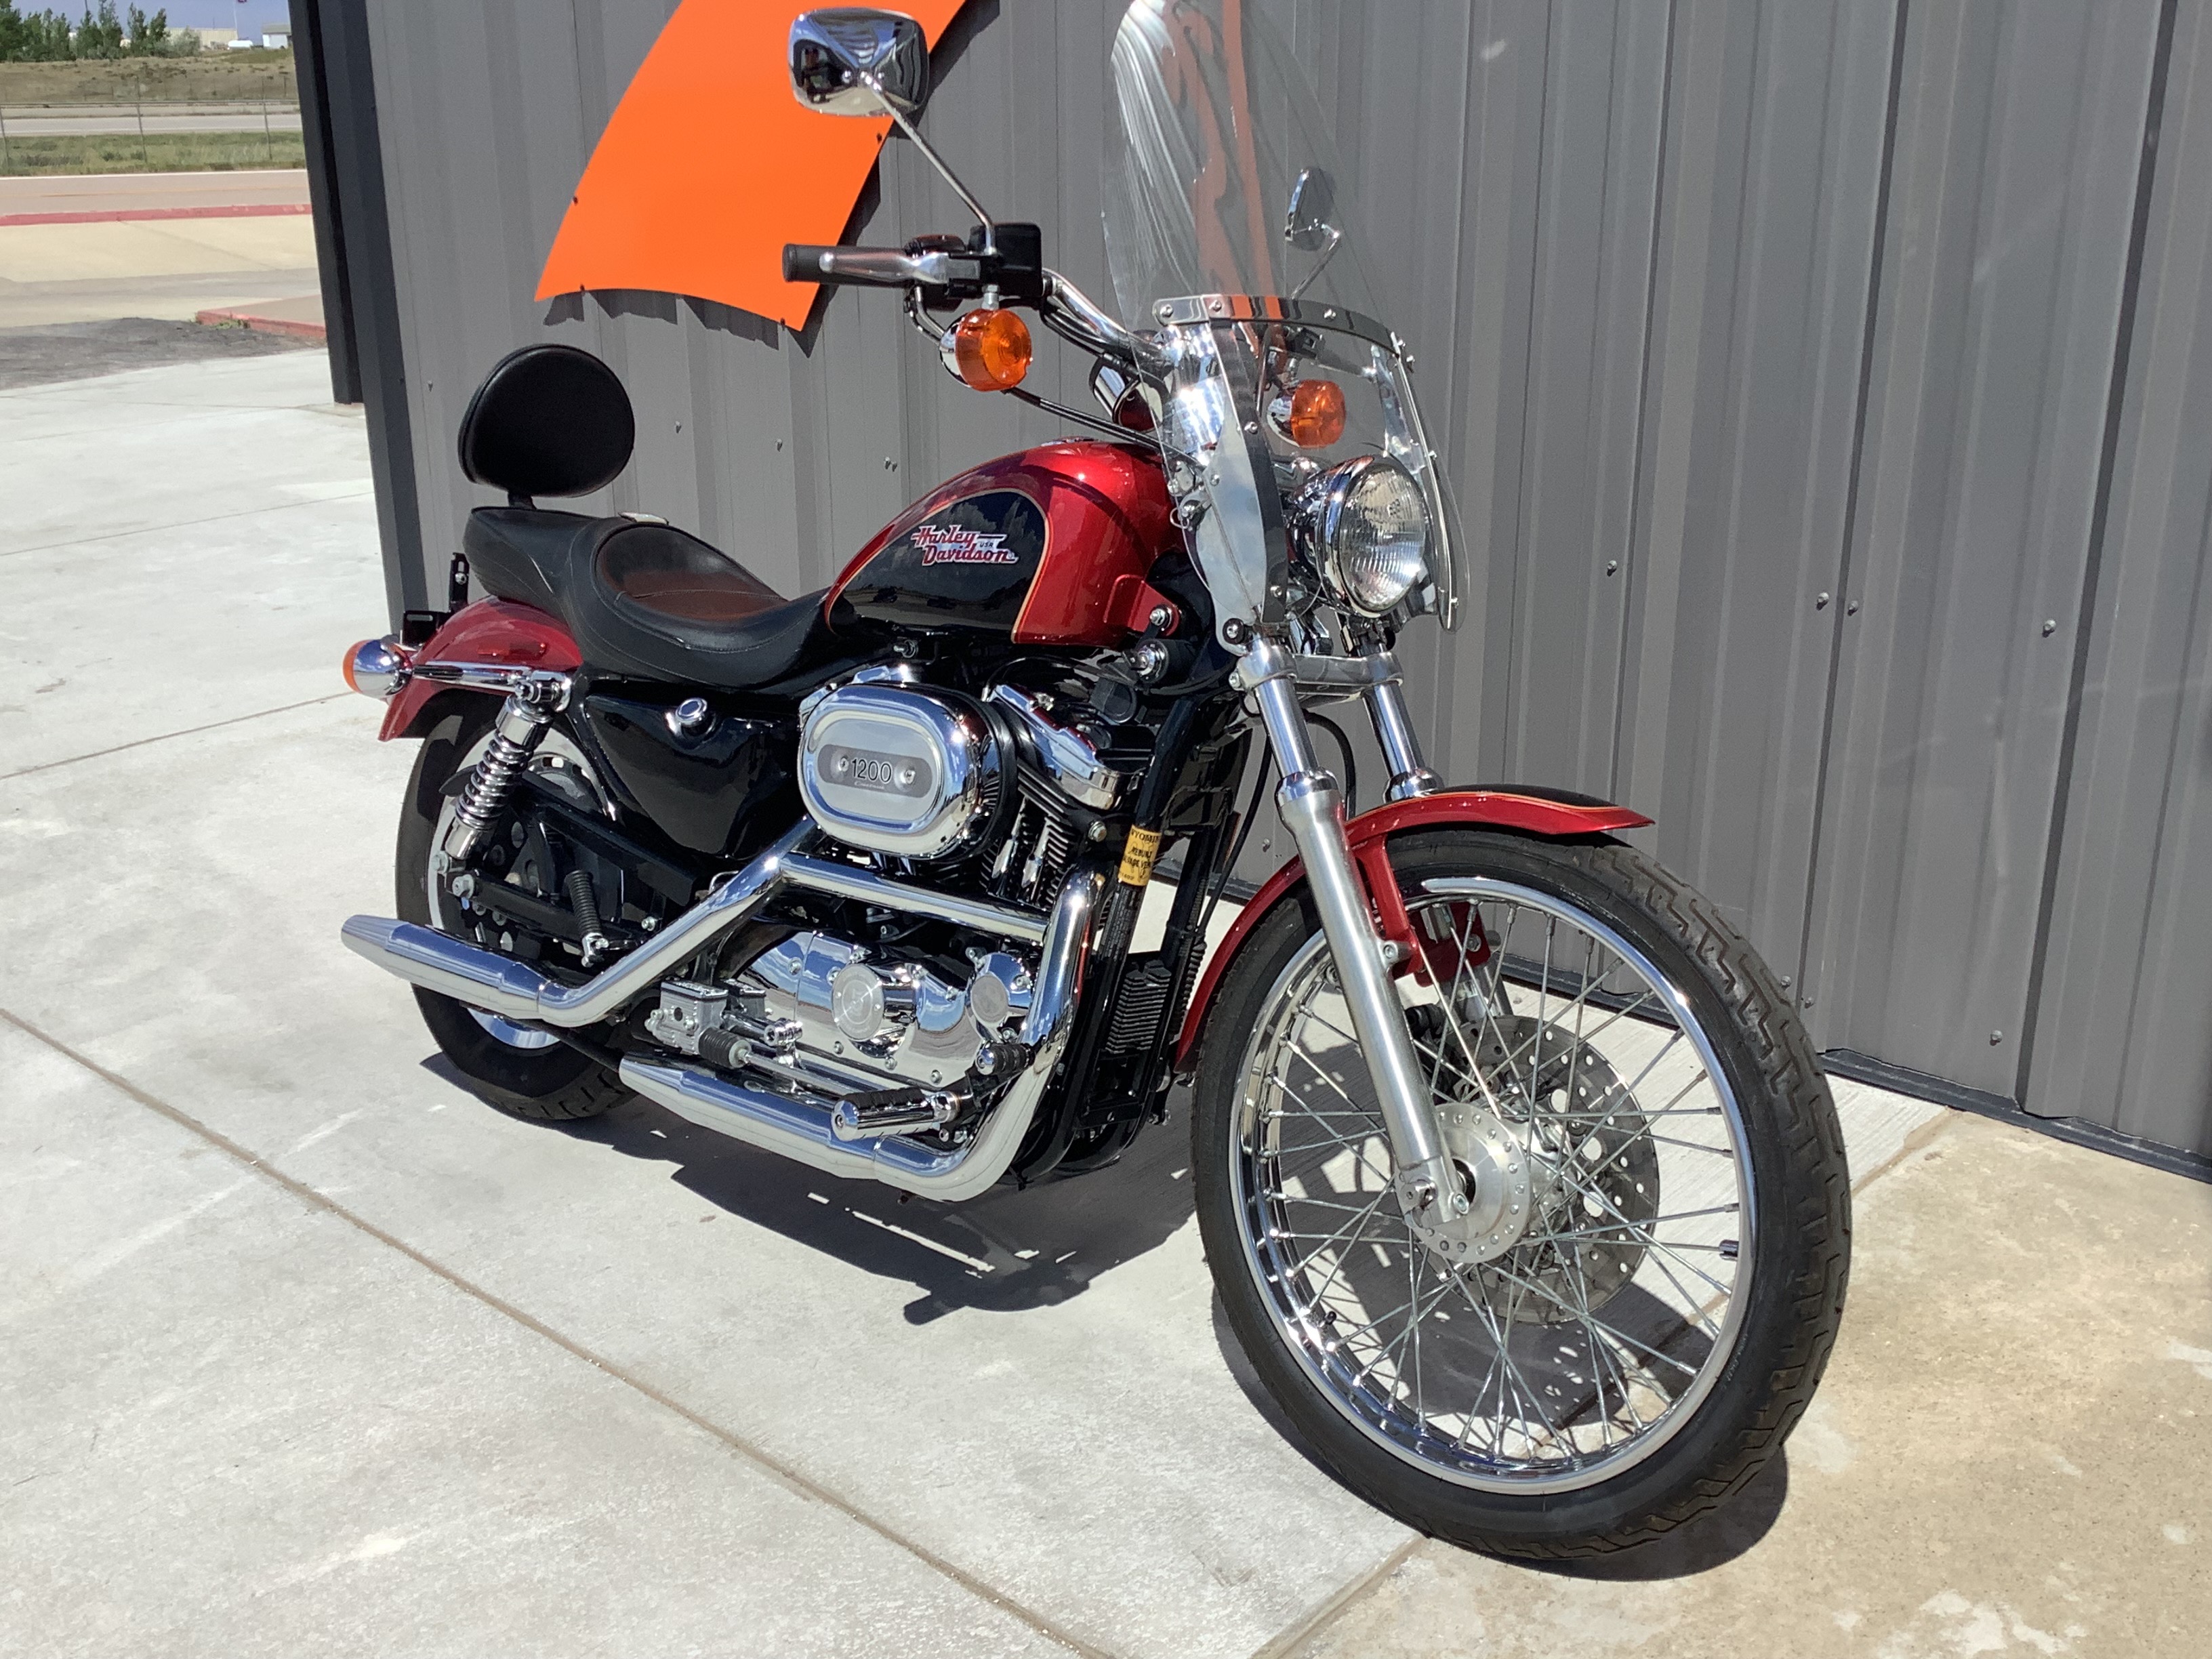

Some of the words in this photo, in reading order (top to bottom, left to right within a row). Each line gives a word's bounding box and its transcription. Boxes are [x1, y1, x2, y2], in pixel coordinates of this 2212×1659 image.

[911, 525, 980, 548] Harley
[922, 544, 1017, 566] Davidson
[851, 757, 893, 784] 1200
